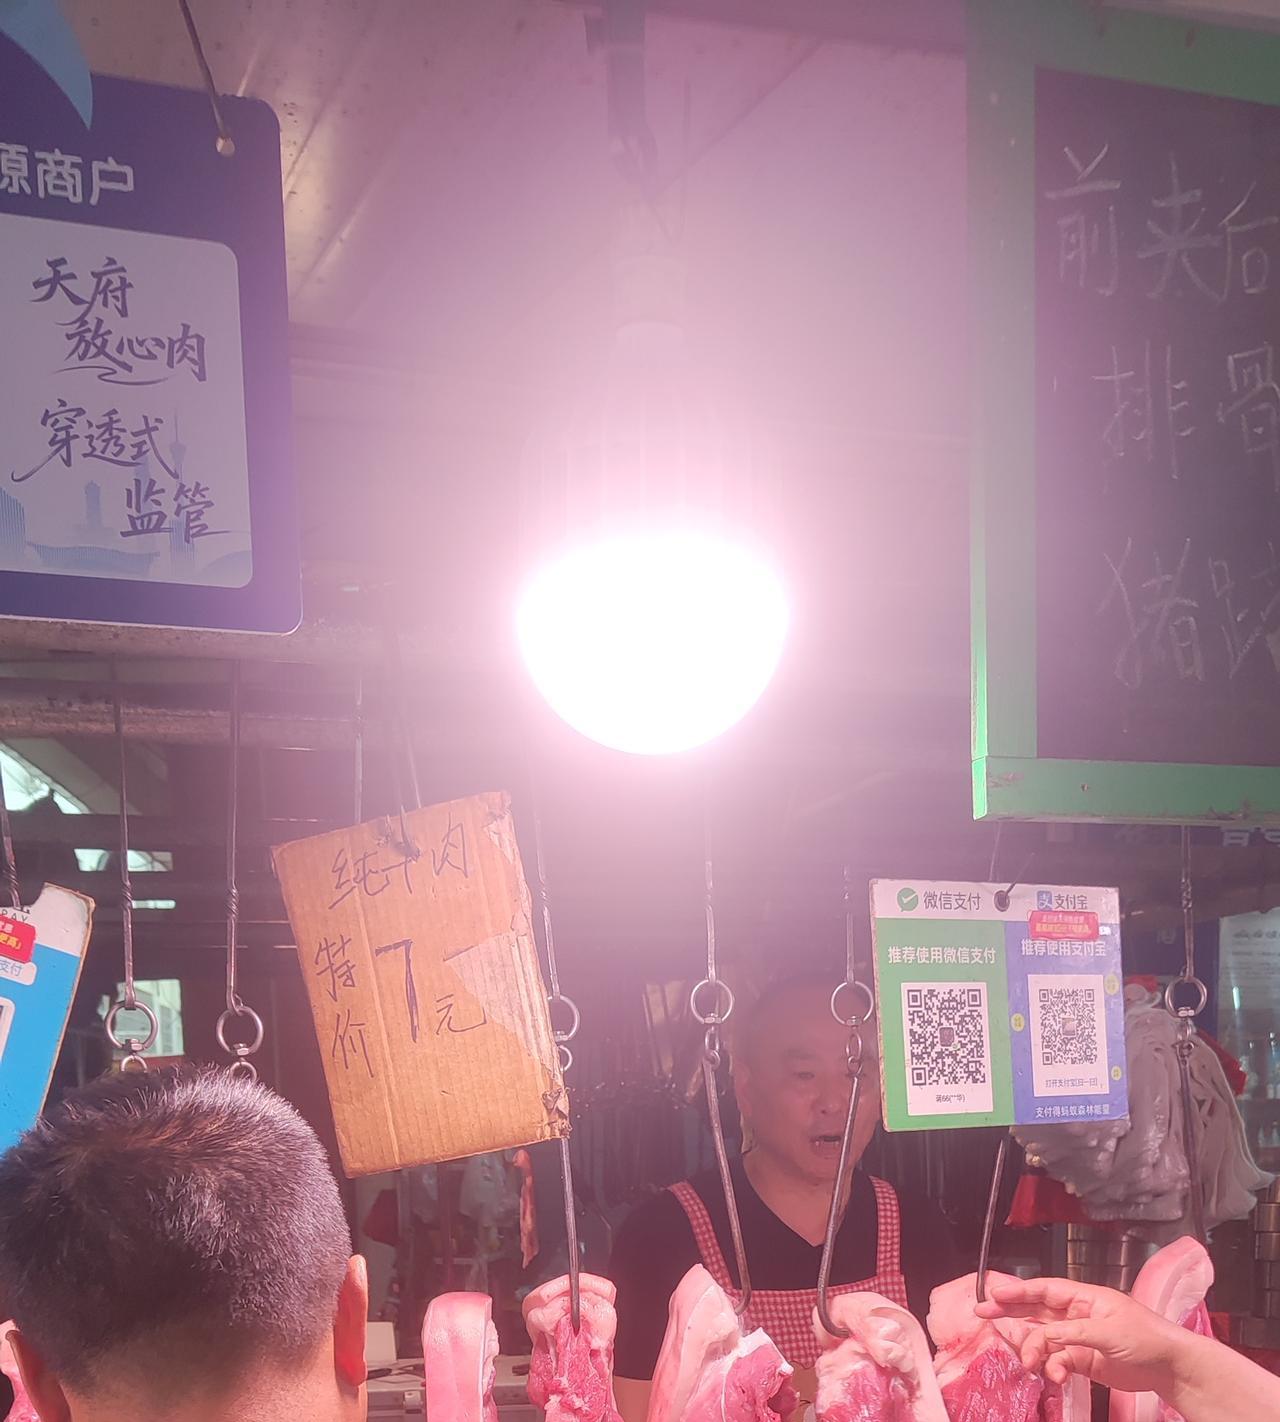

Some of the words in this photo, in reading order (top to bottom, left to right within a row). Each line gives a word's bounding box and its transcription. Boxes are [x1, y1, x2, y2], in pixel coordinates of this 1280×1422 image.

[29, 256, 134, 326] 天府
[64, 316, 208, 382] 放心肉
[11, 398, 180, 483] 穿透式
[119, 478, 232, 544] 监管
[924, 890, 981, 911] 微信支付
[1054, 894, 1088, 910] 支付宝
[888, 945, 997, 965] 推荐使用微信支付
[1021, 939, 1107, 957] 推荐使用支付宝
[314, 932, 374, 1078] 特价
